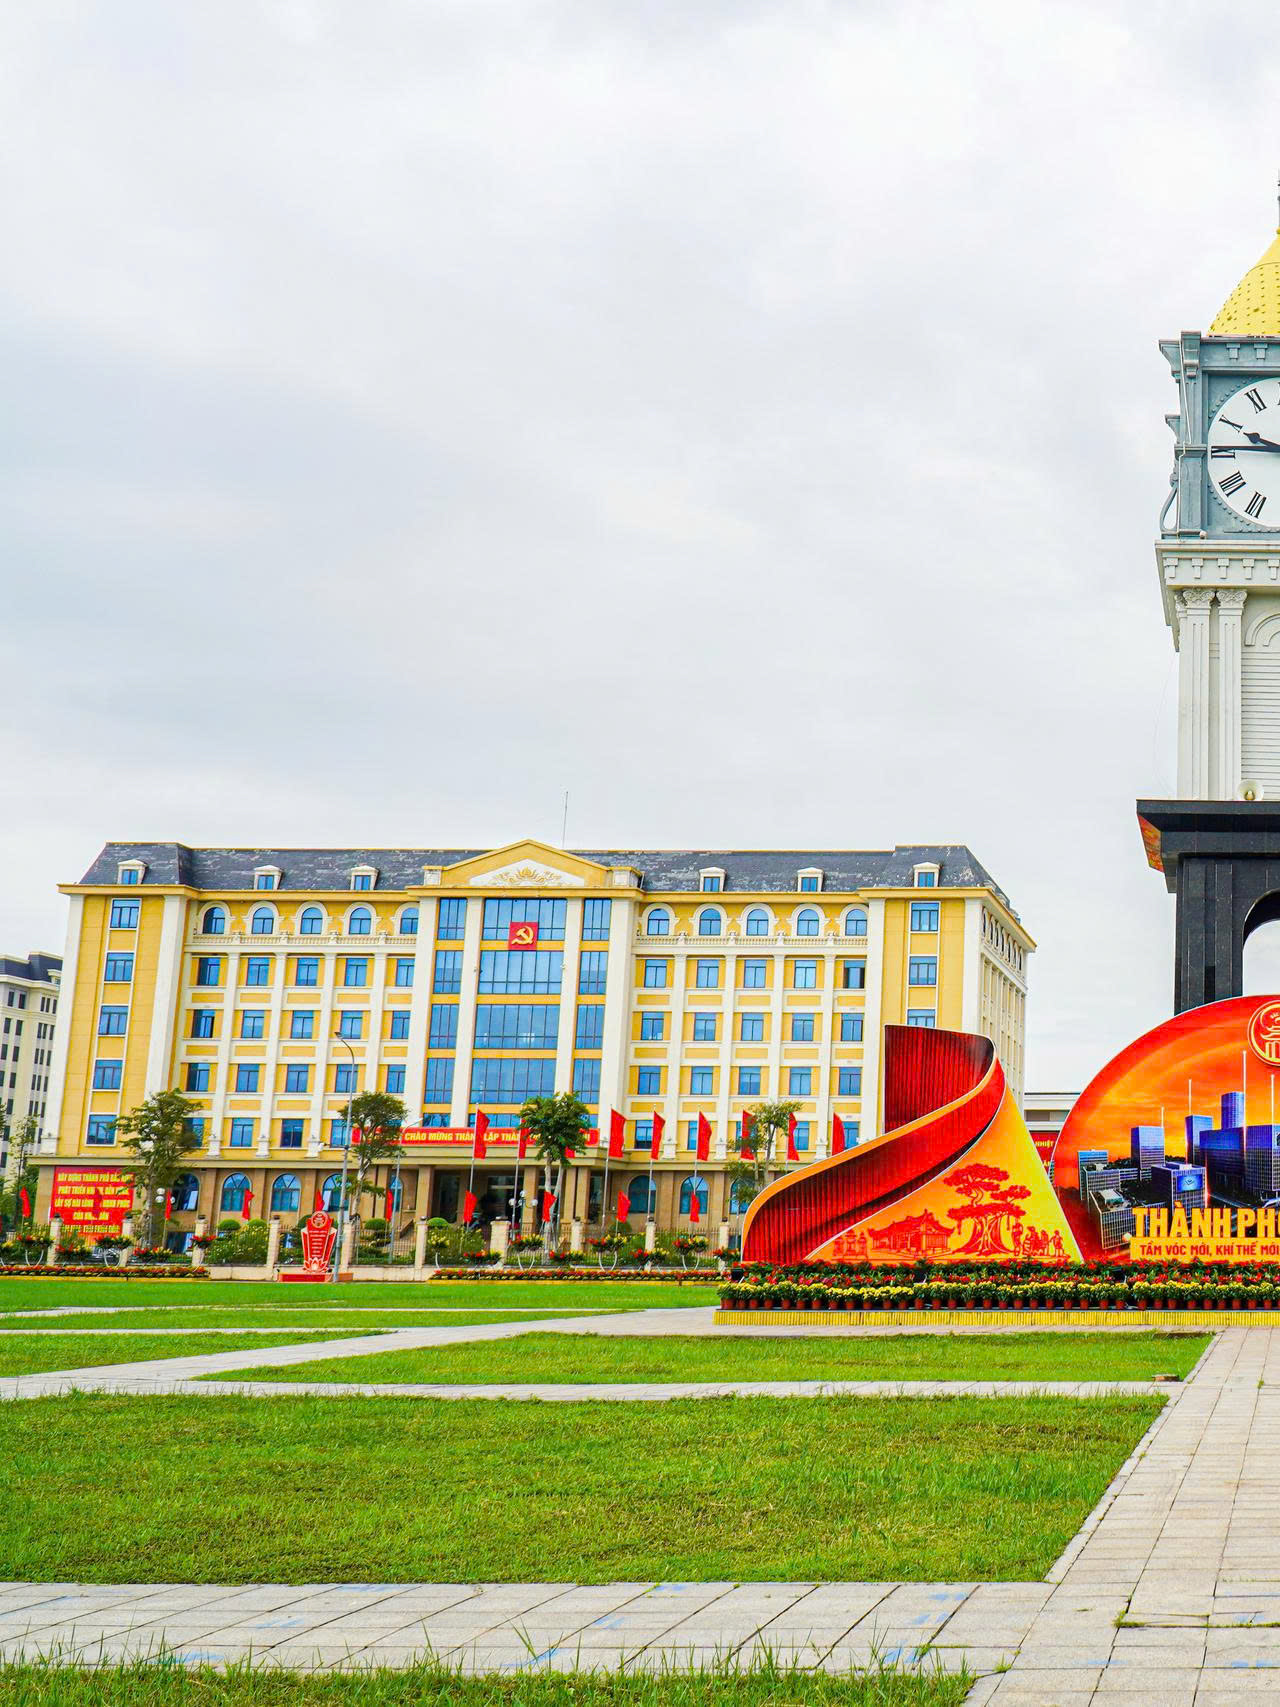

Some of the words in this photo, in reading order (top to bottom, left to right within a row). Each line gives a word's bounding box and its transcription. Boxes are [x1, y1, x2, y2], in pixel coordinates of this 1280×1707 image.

[1244, 388, 1267, 414] XI
[1219, 415, 1243, 432] X
[1218, 471, 1246, 497] VIII
[1245, 492, 1266, 518] VII
[405, 1131, 426, 1141] CHÀO
[428, 1131, 453, 1141] MỪNG
[455, 1131, 475, 1141] THÀN
[483, 1132, 500, 1143] LẬP
[1132, 1200, 1232, 1238] THÀNH
[1140, 1241, 1162, 1256] TẦM
[1165, 1242, 1187, 1256] VÓC
[1190, 1242, 1212, 1257] MỚI,
[1215, 1242, 1234, 1256] KHÍ
[1236, 1240, 1257, 1256] THẾ
